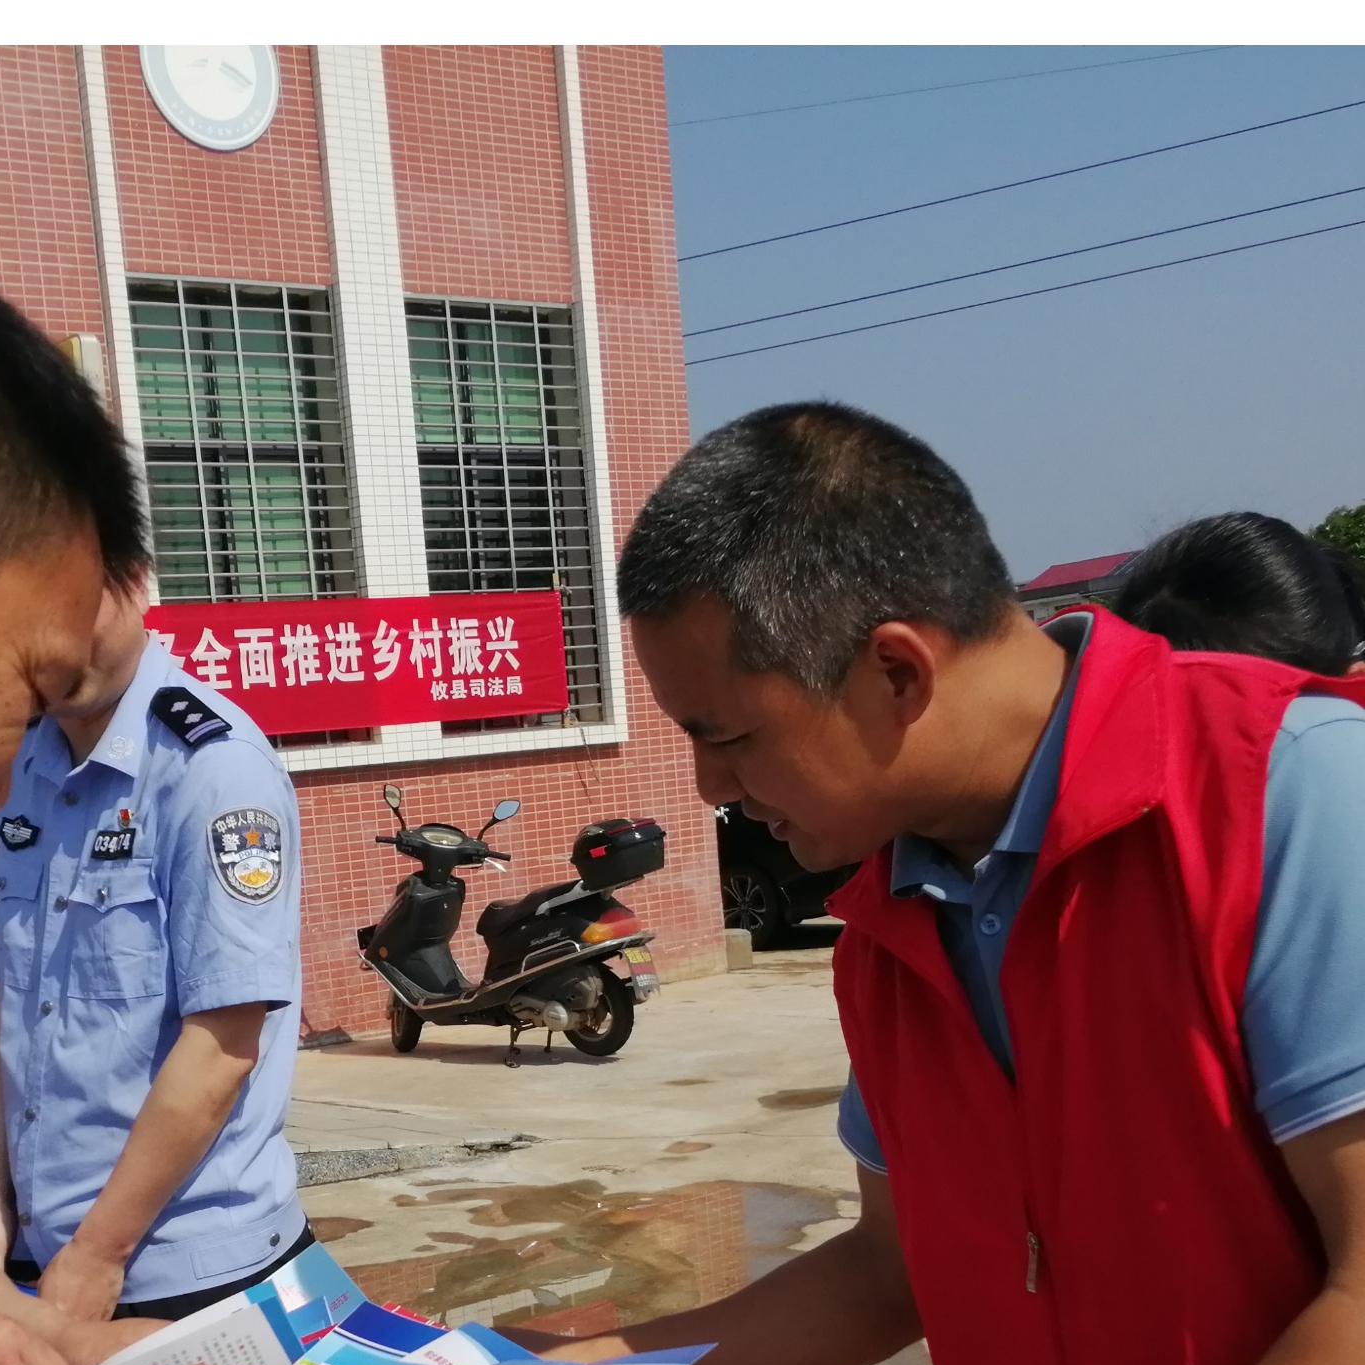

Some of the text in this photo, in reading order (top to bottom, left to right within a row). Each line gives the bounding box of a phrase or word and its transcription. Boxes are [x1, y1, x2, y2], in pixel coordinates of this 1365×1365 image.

[430, 676, 523, 702] 攸县司法局
